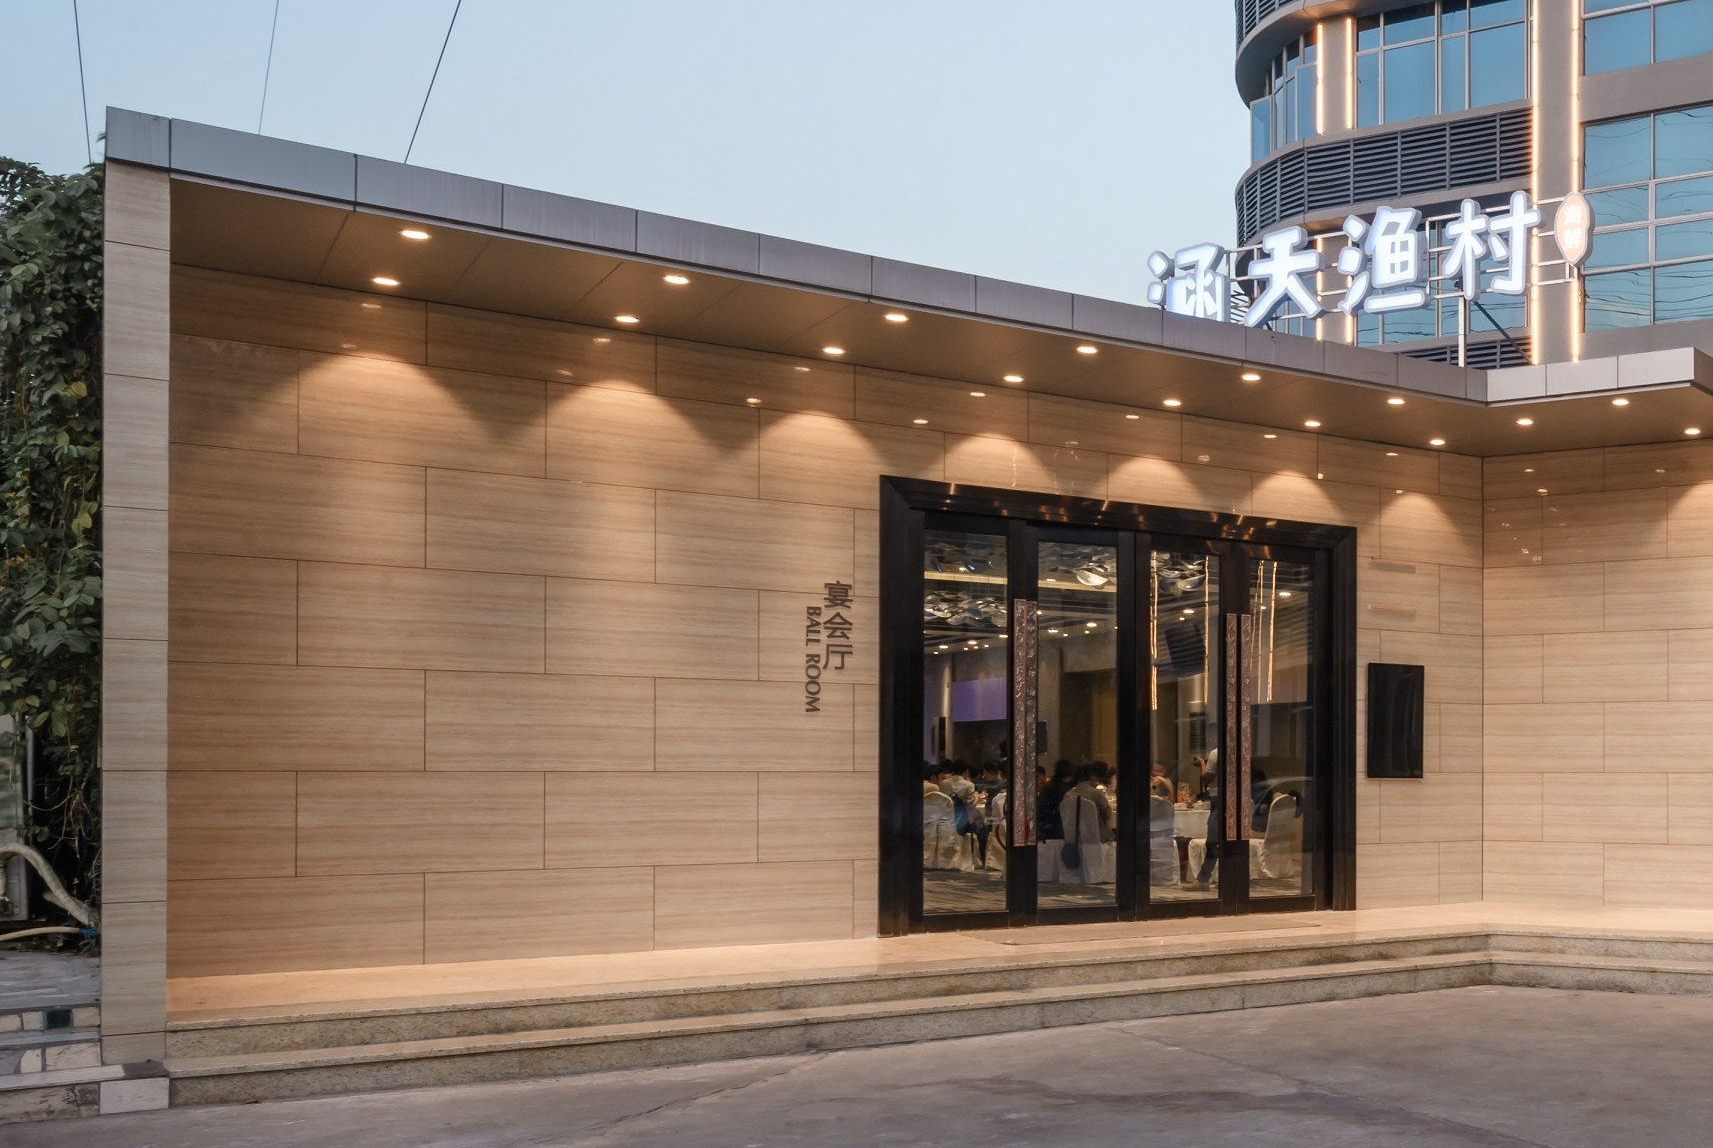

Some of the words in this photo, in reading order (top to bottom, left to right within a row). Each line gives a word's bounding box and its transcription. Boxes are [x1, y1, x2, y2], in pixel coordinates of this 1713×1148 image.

[1147, 190, 1546, 328] 涵天渔村
[805, 606, 822, 647] BALL
[822, 580, 854, 671] 宴会厅
[805, 653, 821, 713] ROOM
